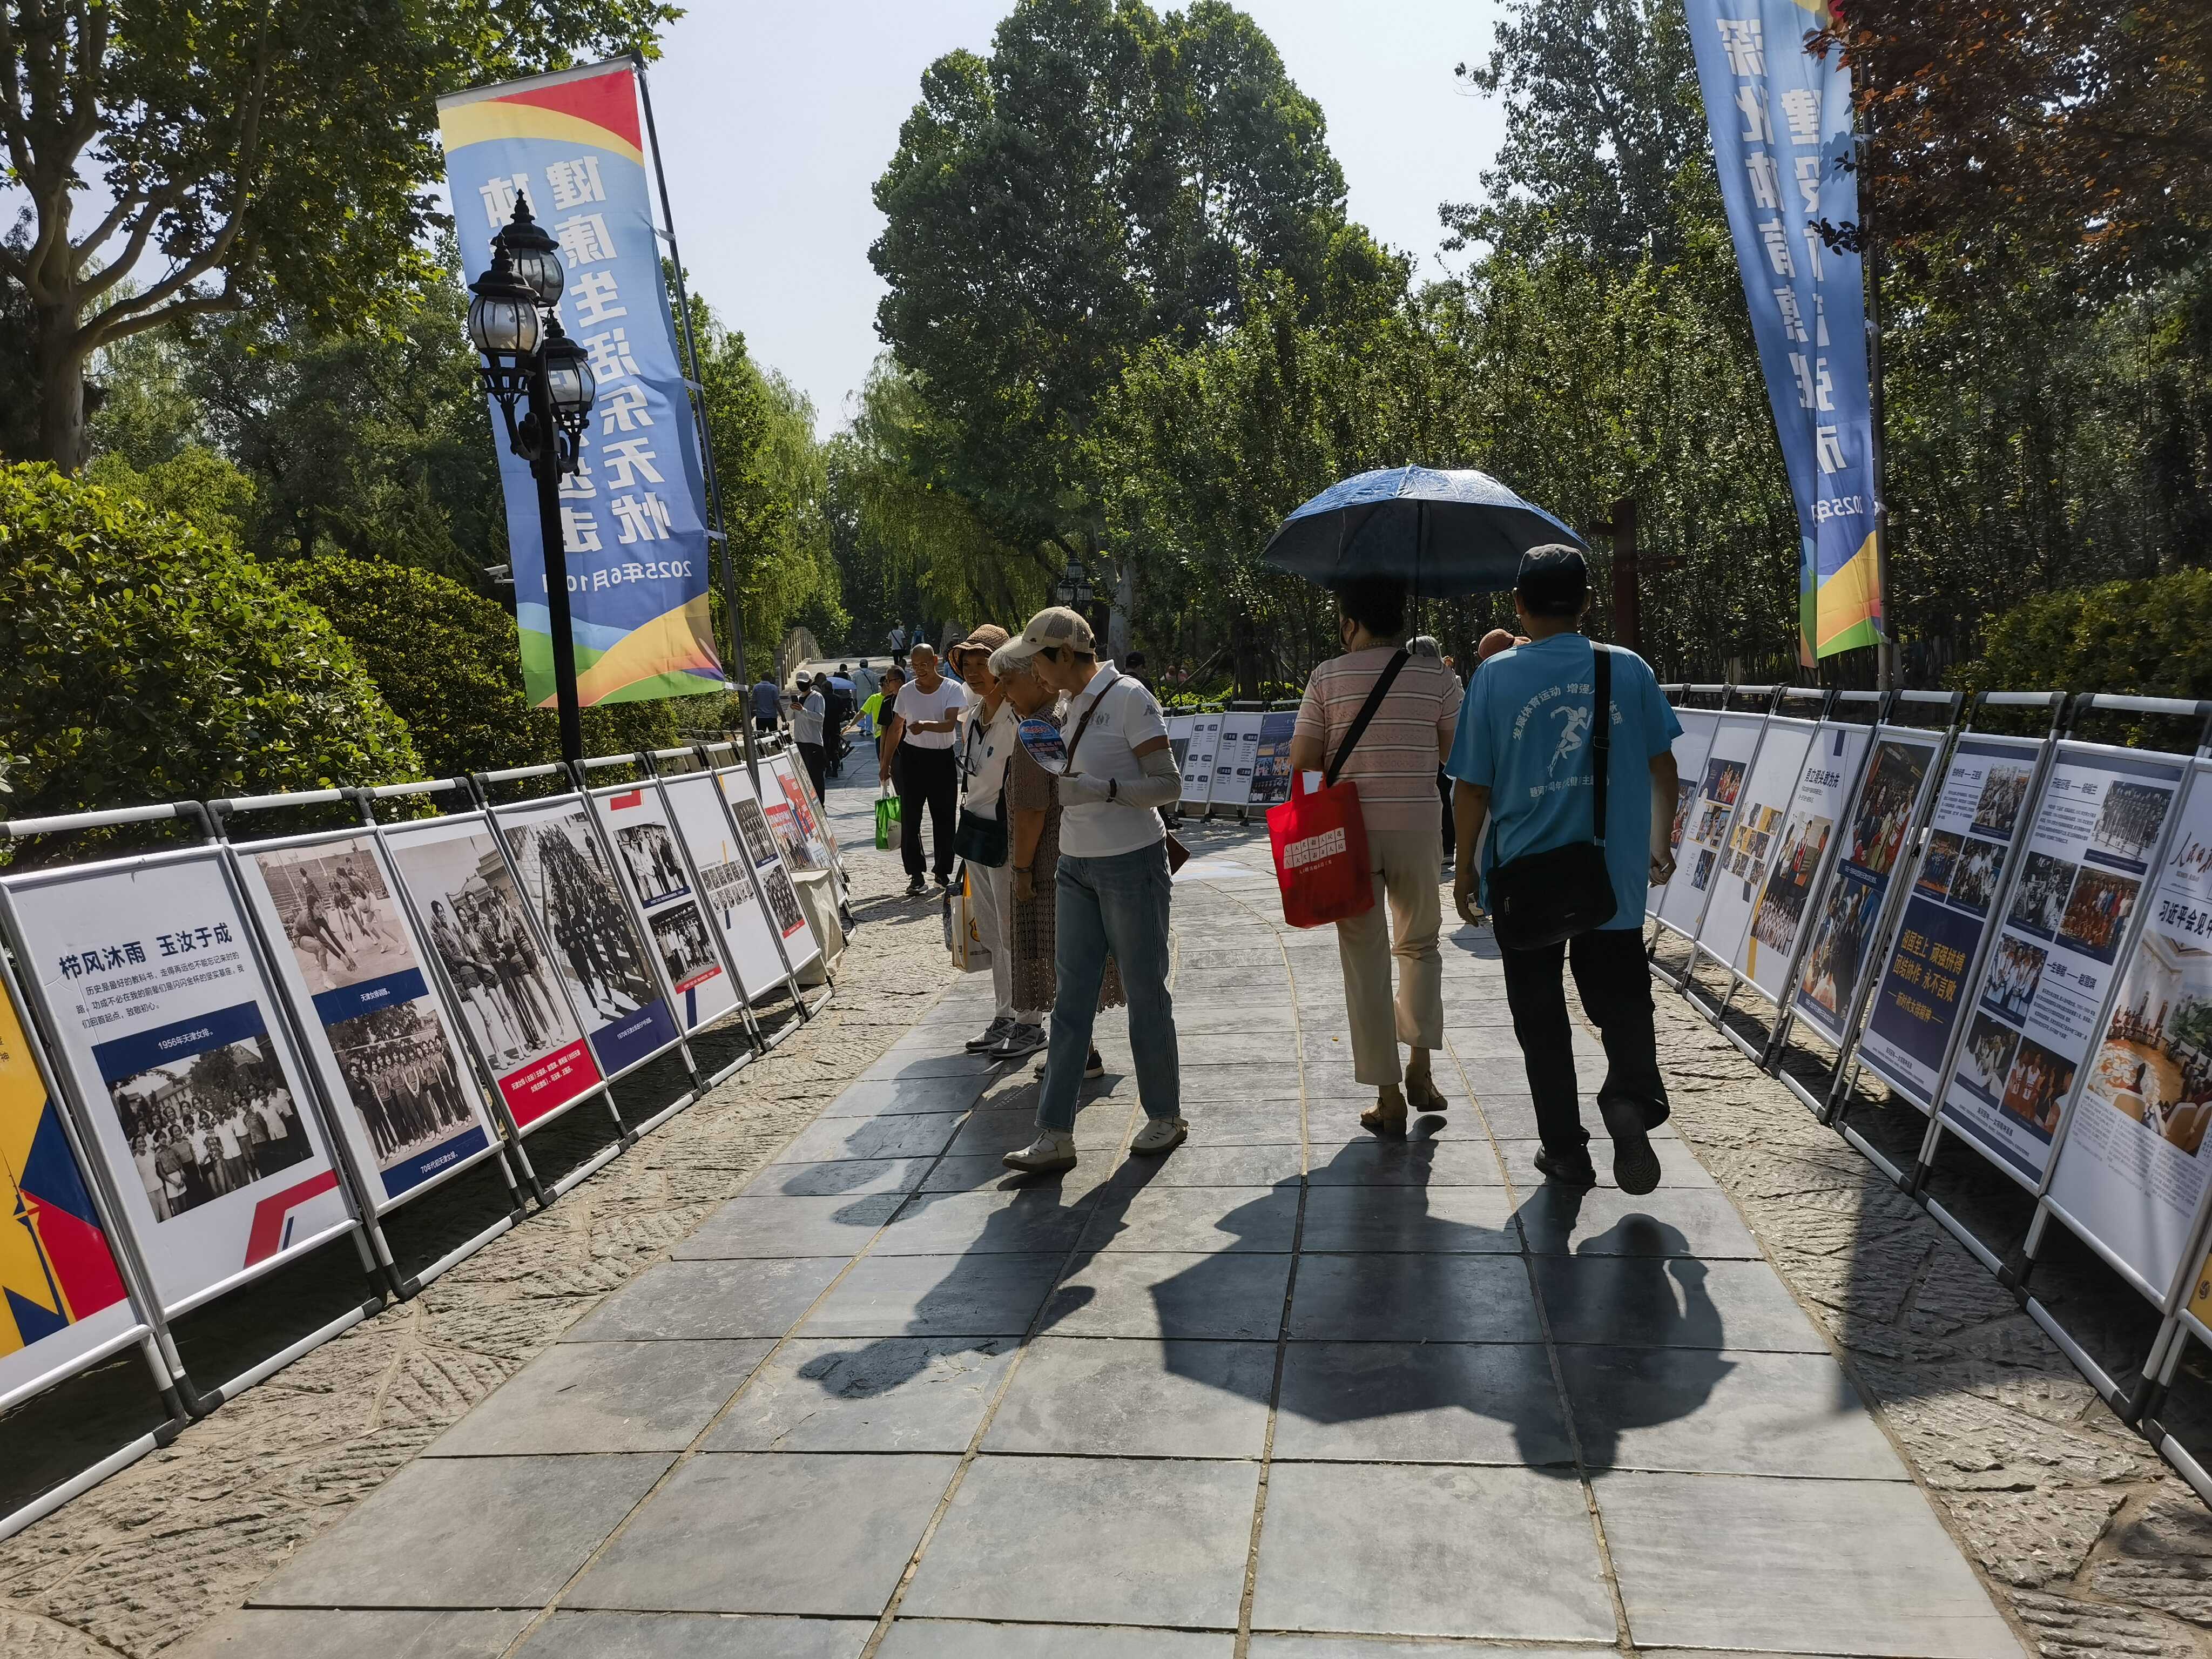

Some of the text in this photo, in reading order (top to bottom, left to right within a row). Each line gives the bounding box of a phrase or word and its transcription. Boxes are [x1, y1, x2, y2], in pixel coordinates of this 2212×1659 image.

[1513, 683, 1623, 740] 发展体育运动 增强体质
[59, 922, 232, 980] 栉风沐雨 玉汝于成
[1921, 968, 1957, 1003] 永不言败
[158, 1028, 214, 1050] 1956年天津女排。
